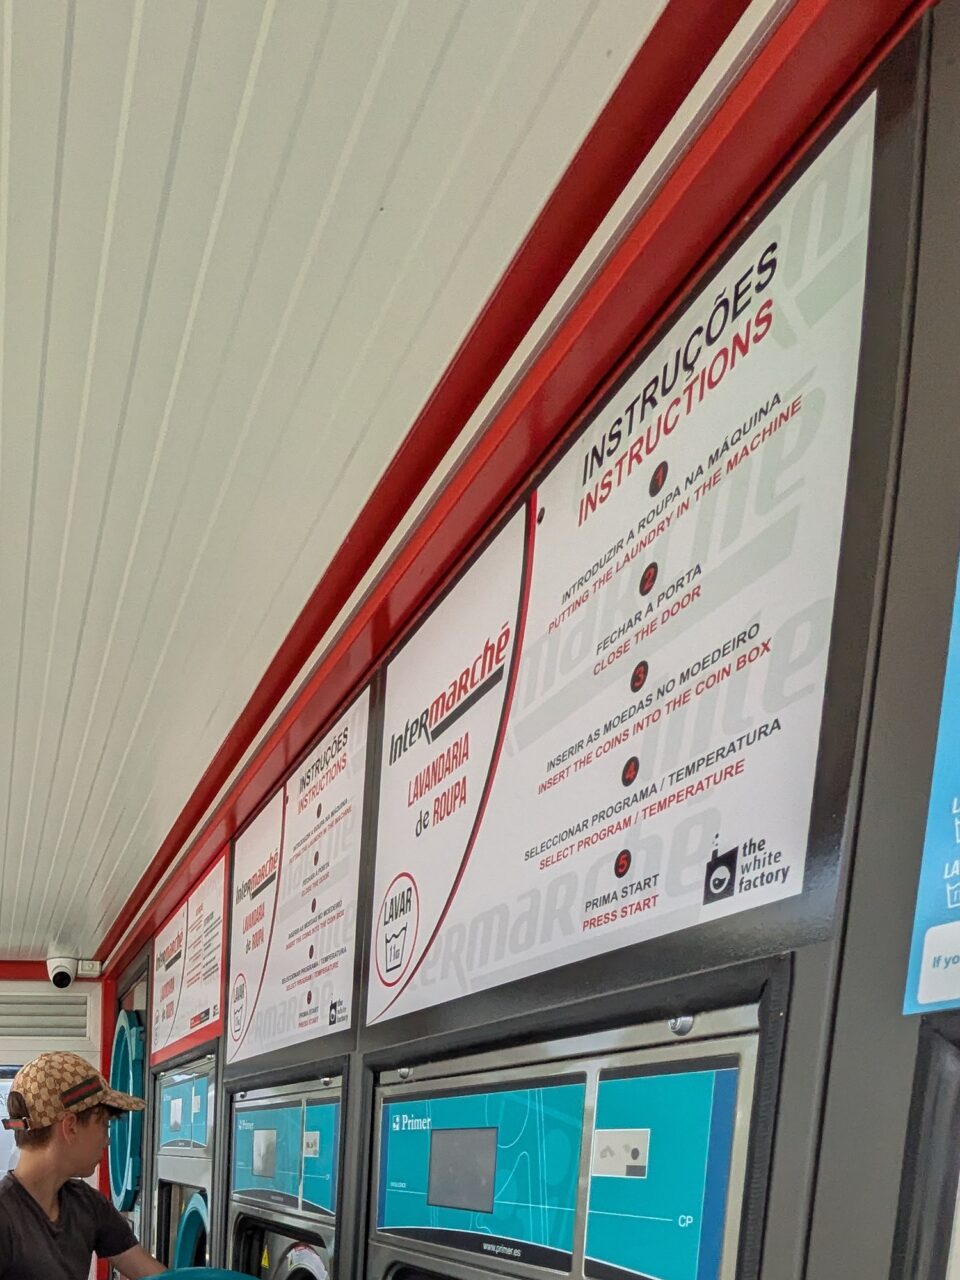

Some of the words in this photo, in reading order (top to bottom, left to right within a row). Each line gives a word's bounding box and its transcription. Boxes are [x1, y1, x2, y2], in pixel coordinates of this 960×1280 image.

[580, 240, 779, 487] INSTRUÇÕES
[576, 296, 774, 528] INSTRUCTIONS
[547, 591, 590, 633] PUTTING
[591, 567, 613, 594] THE
[614, 513, 673, 573] LAUNDRY
[675, 498, 690, 518] IN
[693, 467, 722, 501] THE
[725, 395, 802, 474] MACHINE
[560, 537, 625, 606] INTRODUZIR
[624, 527, 635, 546] A
[636, 484, 682, 535] ROUPA
[683, 463, 705, 491] NA
[706, 391, 782, 470] MÁQUINA
[592, 638, 631, 676] CLOSE
[633, 616, 659, 641] THE
[659, 583, 702, 626] DOOR
[595, 609, 643, 656] FECHAR
[643, 601, 654, 618] A
[655, 562, 702, 609] PORTA
[389, 621, 510, 766] Intermarché
[537, 763, 572, 795] INSERT
[572, 750, 594, 773] THE
[594, 728, 630, 759] COINS
[631, 707, 662, 734] INTO
[664, 687, 692, 715] THE
[694, 663, 732, 696] COIN
[735, 637, 772, 672] BOX
[545, 738, 585, 773] INSERIR
[584, 727, 601, 748] AS
[601, 692, 654, 736] MOEDAS
[655, 677, 676, 701] NO
[678, 621, 761, 686] MOEDEIRO
[407, 732, 469, 808] LAVANDARIA
[415, 810, 430, 837] de
[432, 775, 467, 827] ROUPA
[523, 817, 589, 862] SELECCIONAR
[590, 782, 658, 827] PROGRAMA
[666, 716, 782, 787] TEMPERATURA
[538, 842, 576, 871] SELECT
[576, 814, 633, 852] PROGRAM
[640, 757, 746, 819] TEMPERATURE
[741, 836, 767, 858] the
[583, 889, 619, 914] PRIMA
[619, 872, 660, 899] START
[737, 864, 791, 894] factory
[739, 850, 782, 876] white
[384, 887, 412, 926] LAVAR
[581, 908, 618, 932] PRESS
[619, 893, 660, 919] START
[933, 955, 941, 969] If
[401, 1113, 431, 1130] Primer
[678, 1214, 694, 1228] CP
